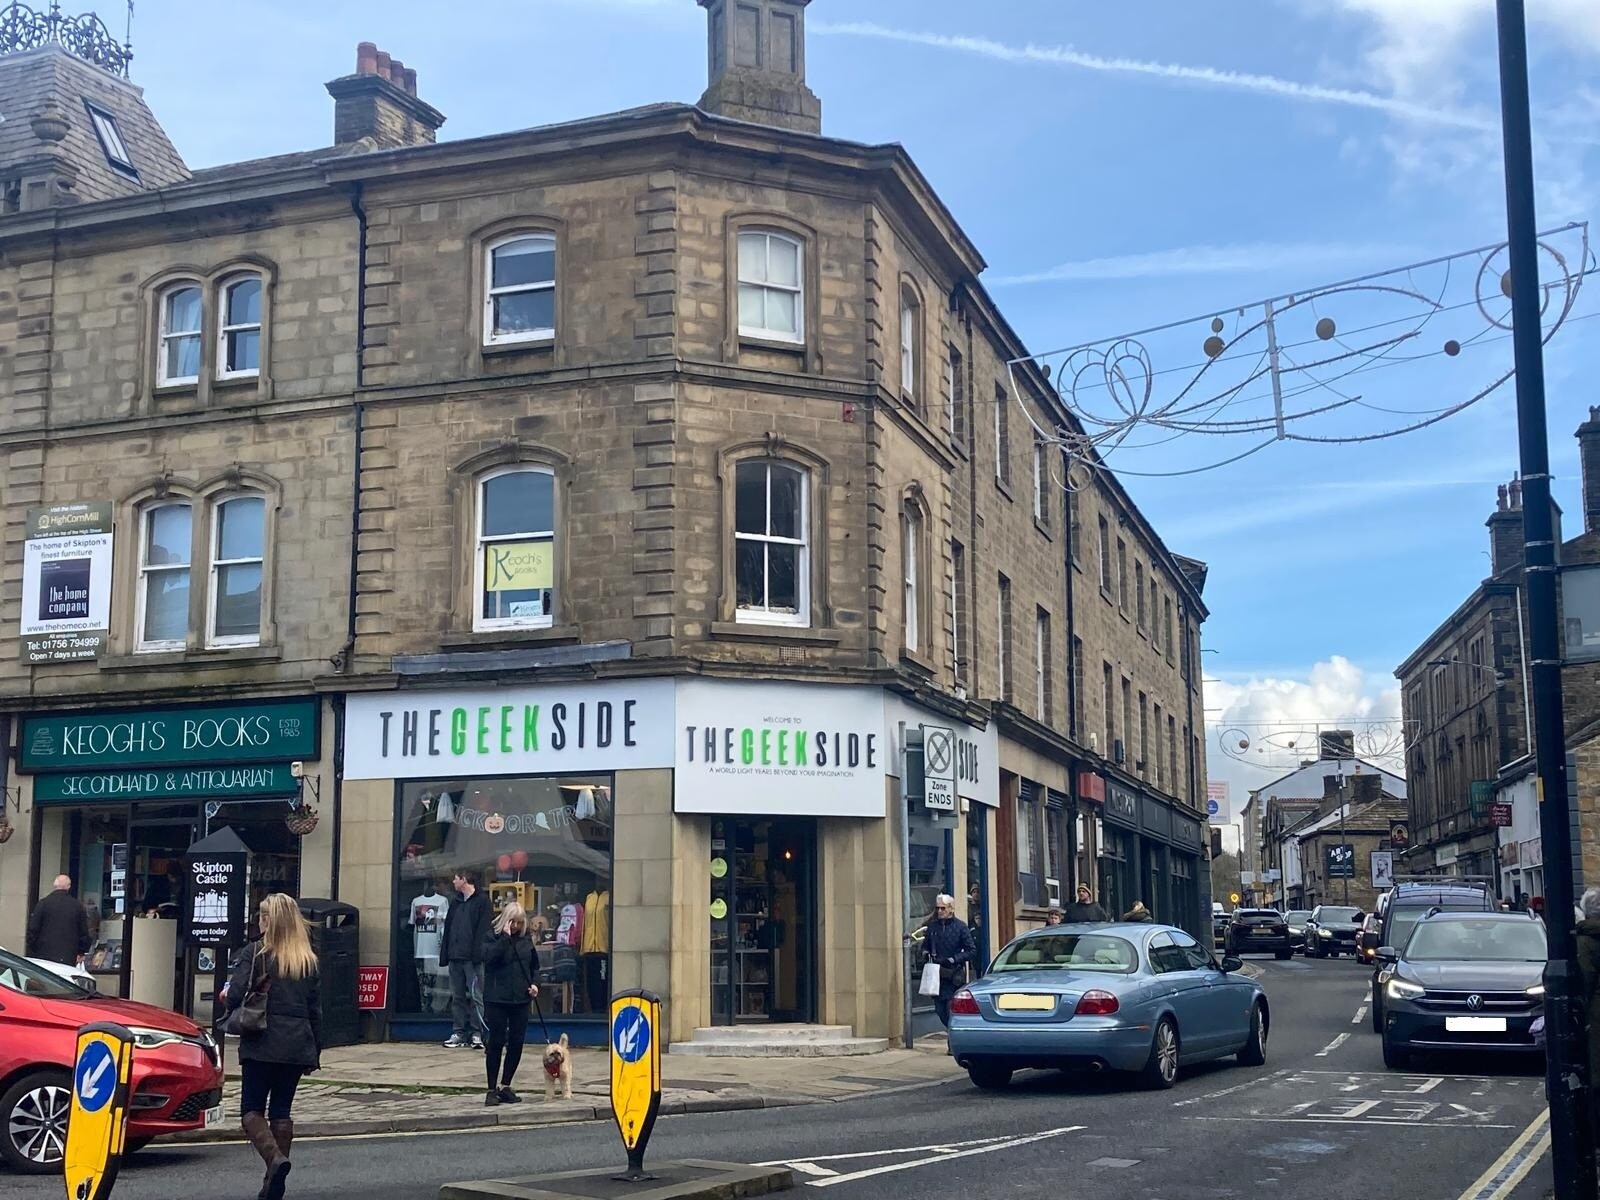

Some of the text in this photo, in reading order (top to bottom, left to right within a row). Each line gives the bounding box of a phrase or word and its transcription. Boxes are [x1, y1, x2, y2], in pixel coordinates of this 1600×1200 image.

[73, 538, 106, 548] Skipton's
[61, 549, 92, 557] furniture
[50, 586, 87, 602] the home
[49, 602, 87, 615] company
[27, 621, 101, 632] www.thehomeco.net
[42, 640, 67, 649] 01756
[70, 637, 100, 647] 794999
[54, 651, 70, 659] days
[279, 718, 300, 728] ESTD
[62, 716, 271, 755] KEOGH'S BOOKS
[959, 739, 978, 784] SIDE
[62, 769, 274, 795] SECONDHAND & ANTIQUARIAN
[932, 781, 947, 791] Zone
[928, 792, 951, 805] ENDS
[192, 862, 233, 875] Skipton
[196, 873, 228, 884] Castle
[209, 928, 228, 936] today
